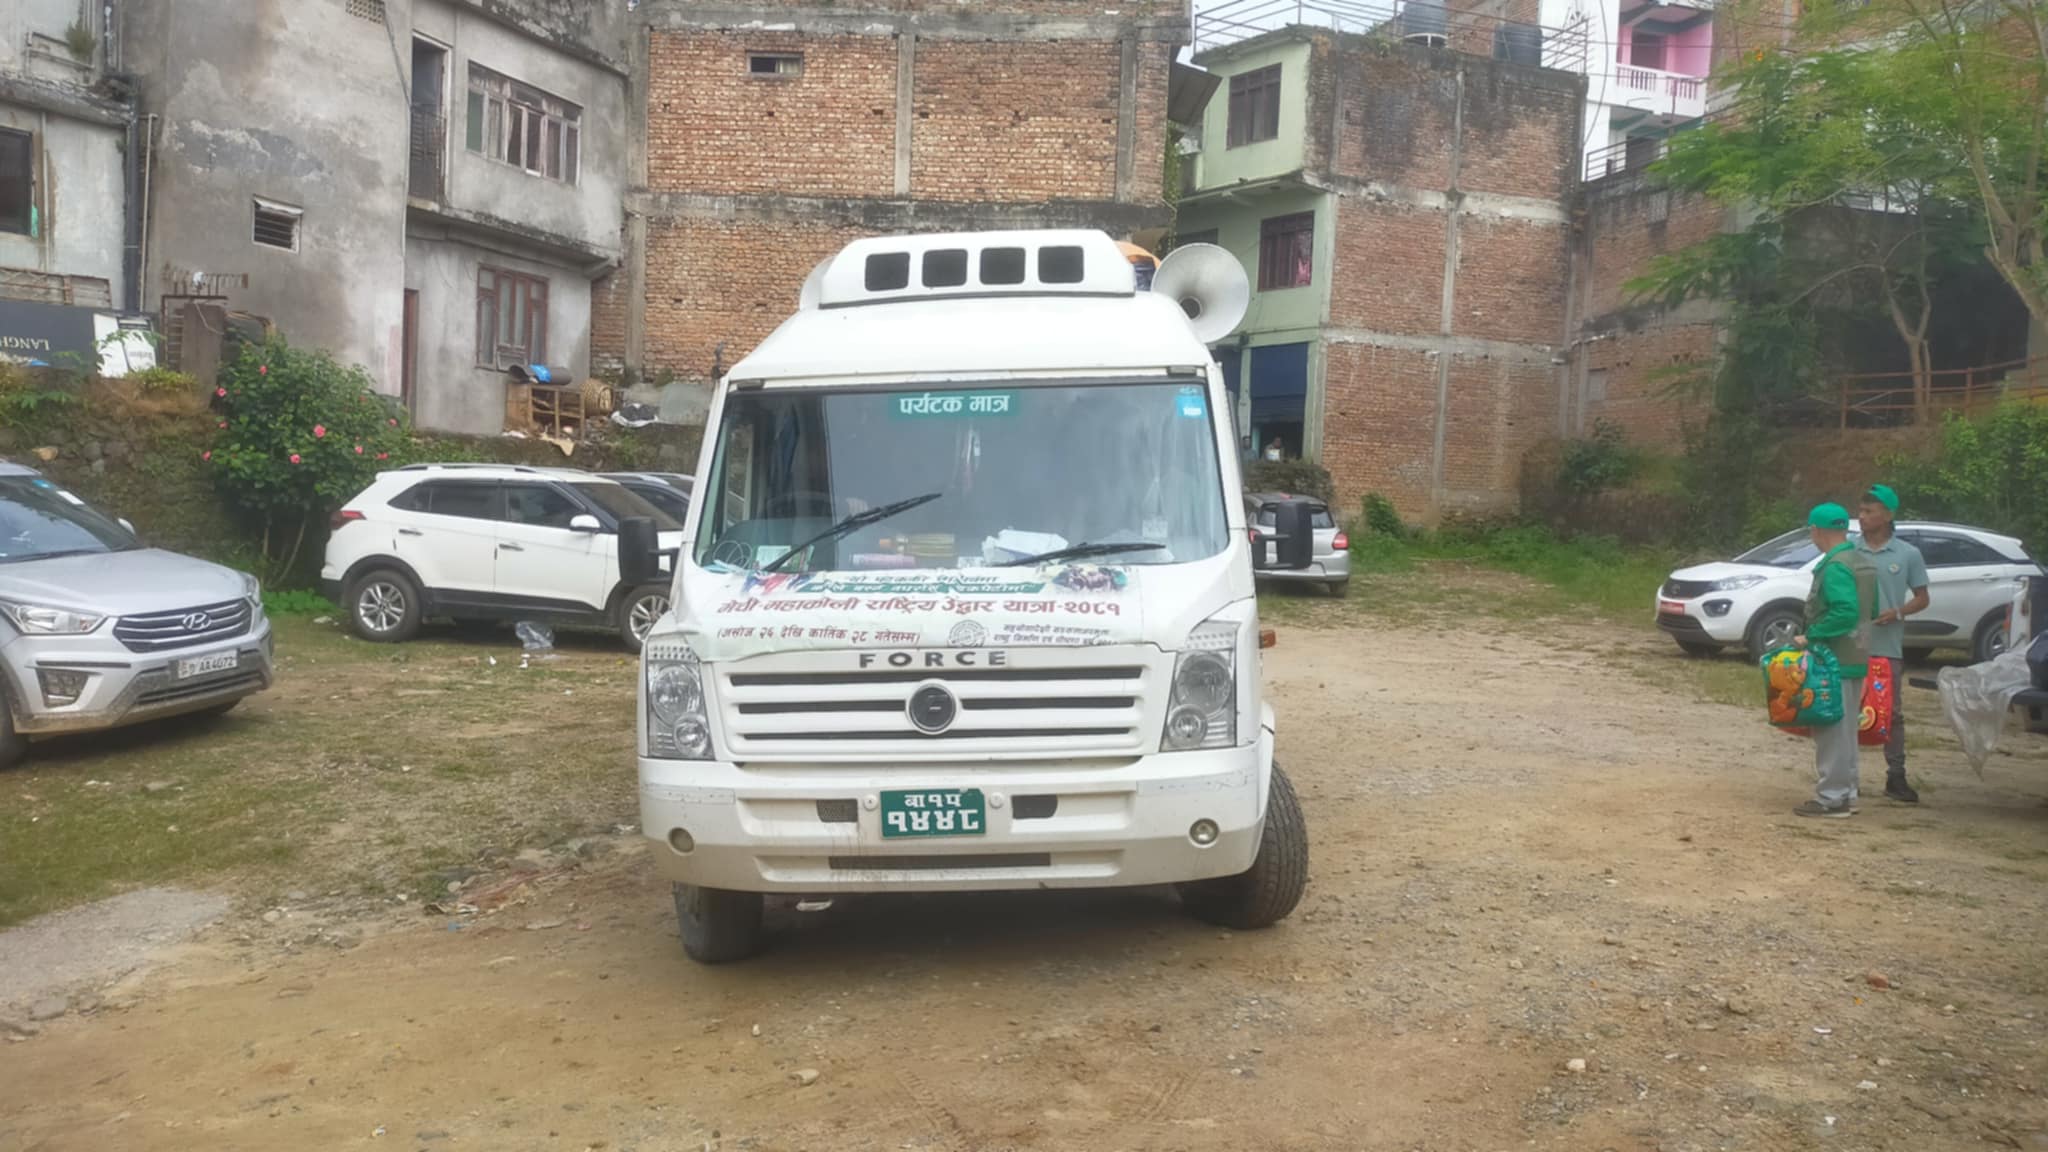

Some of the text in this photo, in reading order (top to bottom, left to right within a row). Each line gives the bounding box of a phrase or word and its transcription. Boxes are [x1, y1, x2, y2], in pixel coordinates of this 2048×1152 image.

[900, 393, 1010, 414] पर्यटक मात्र
[859, 651, 1006, 668] FORCE
